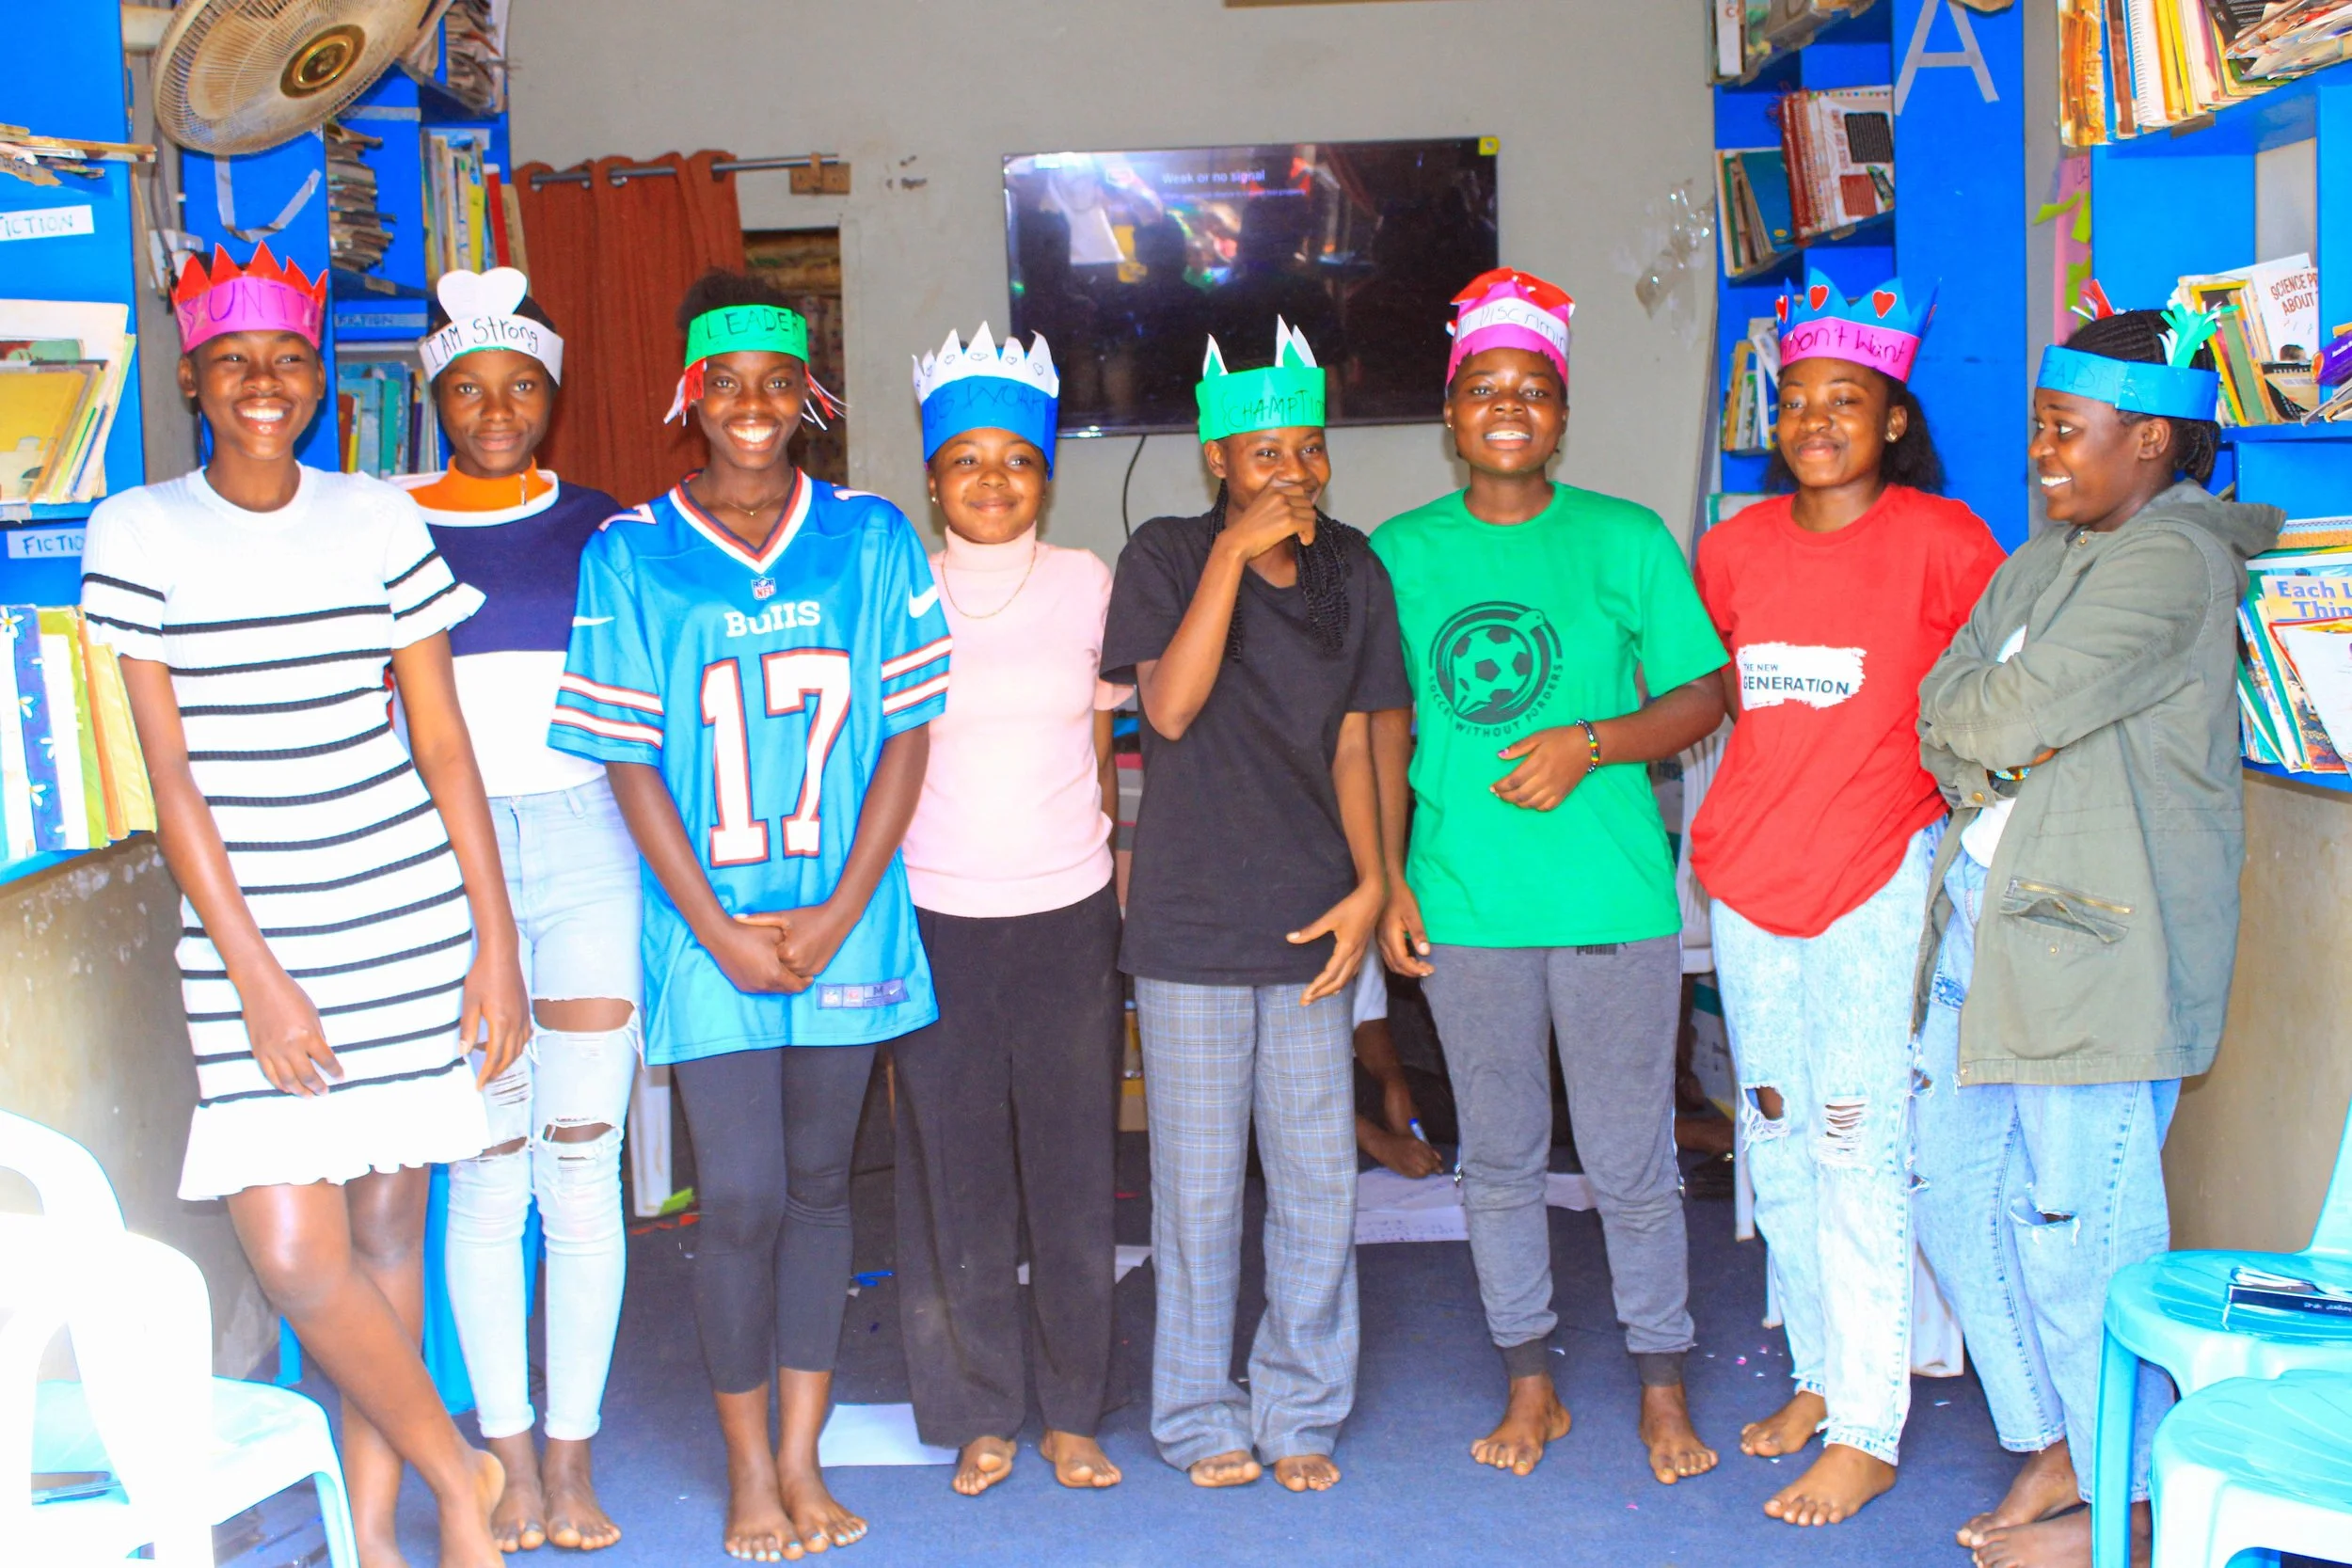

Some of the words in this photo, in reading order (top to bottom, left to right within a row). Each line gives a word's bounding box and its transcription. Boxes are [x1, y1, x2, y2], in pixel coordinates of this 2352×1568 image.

[1197, 173, 1209, 183] or
[1212, 173, 1228, 182] no
[1231, 169, 1265, 185] signal
[0, 213, 73, 237] ICTION
[2270, 274, 2307, 300] SCIENCE
[2281, 292, 2315, 316] ABOUT
[440, 325, 463, 359] AM
[472, 316, 539, 355] Strong
[23, 534, 86, 556] FICTIO
[2276, 580, 2336, 598] Each
[1756, 663, 1779, 672] NEW
[1743, 675, 1851, 695] GENERATION
[1428, 674, 1454, 721] SOCCE
[1455, 721, 1520, 738] WITHOUT
[700, 647, 851, 870] 17
